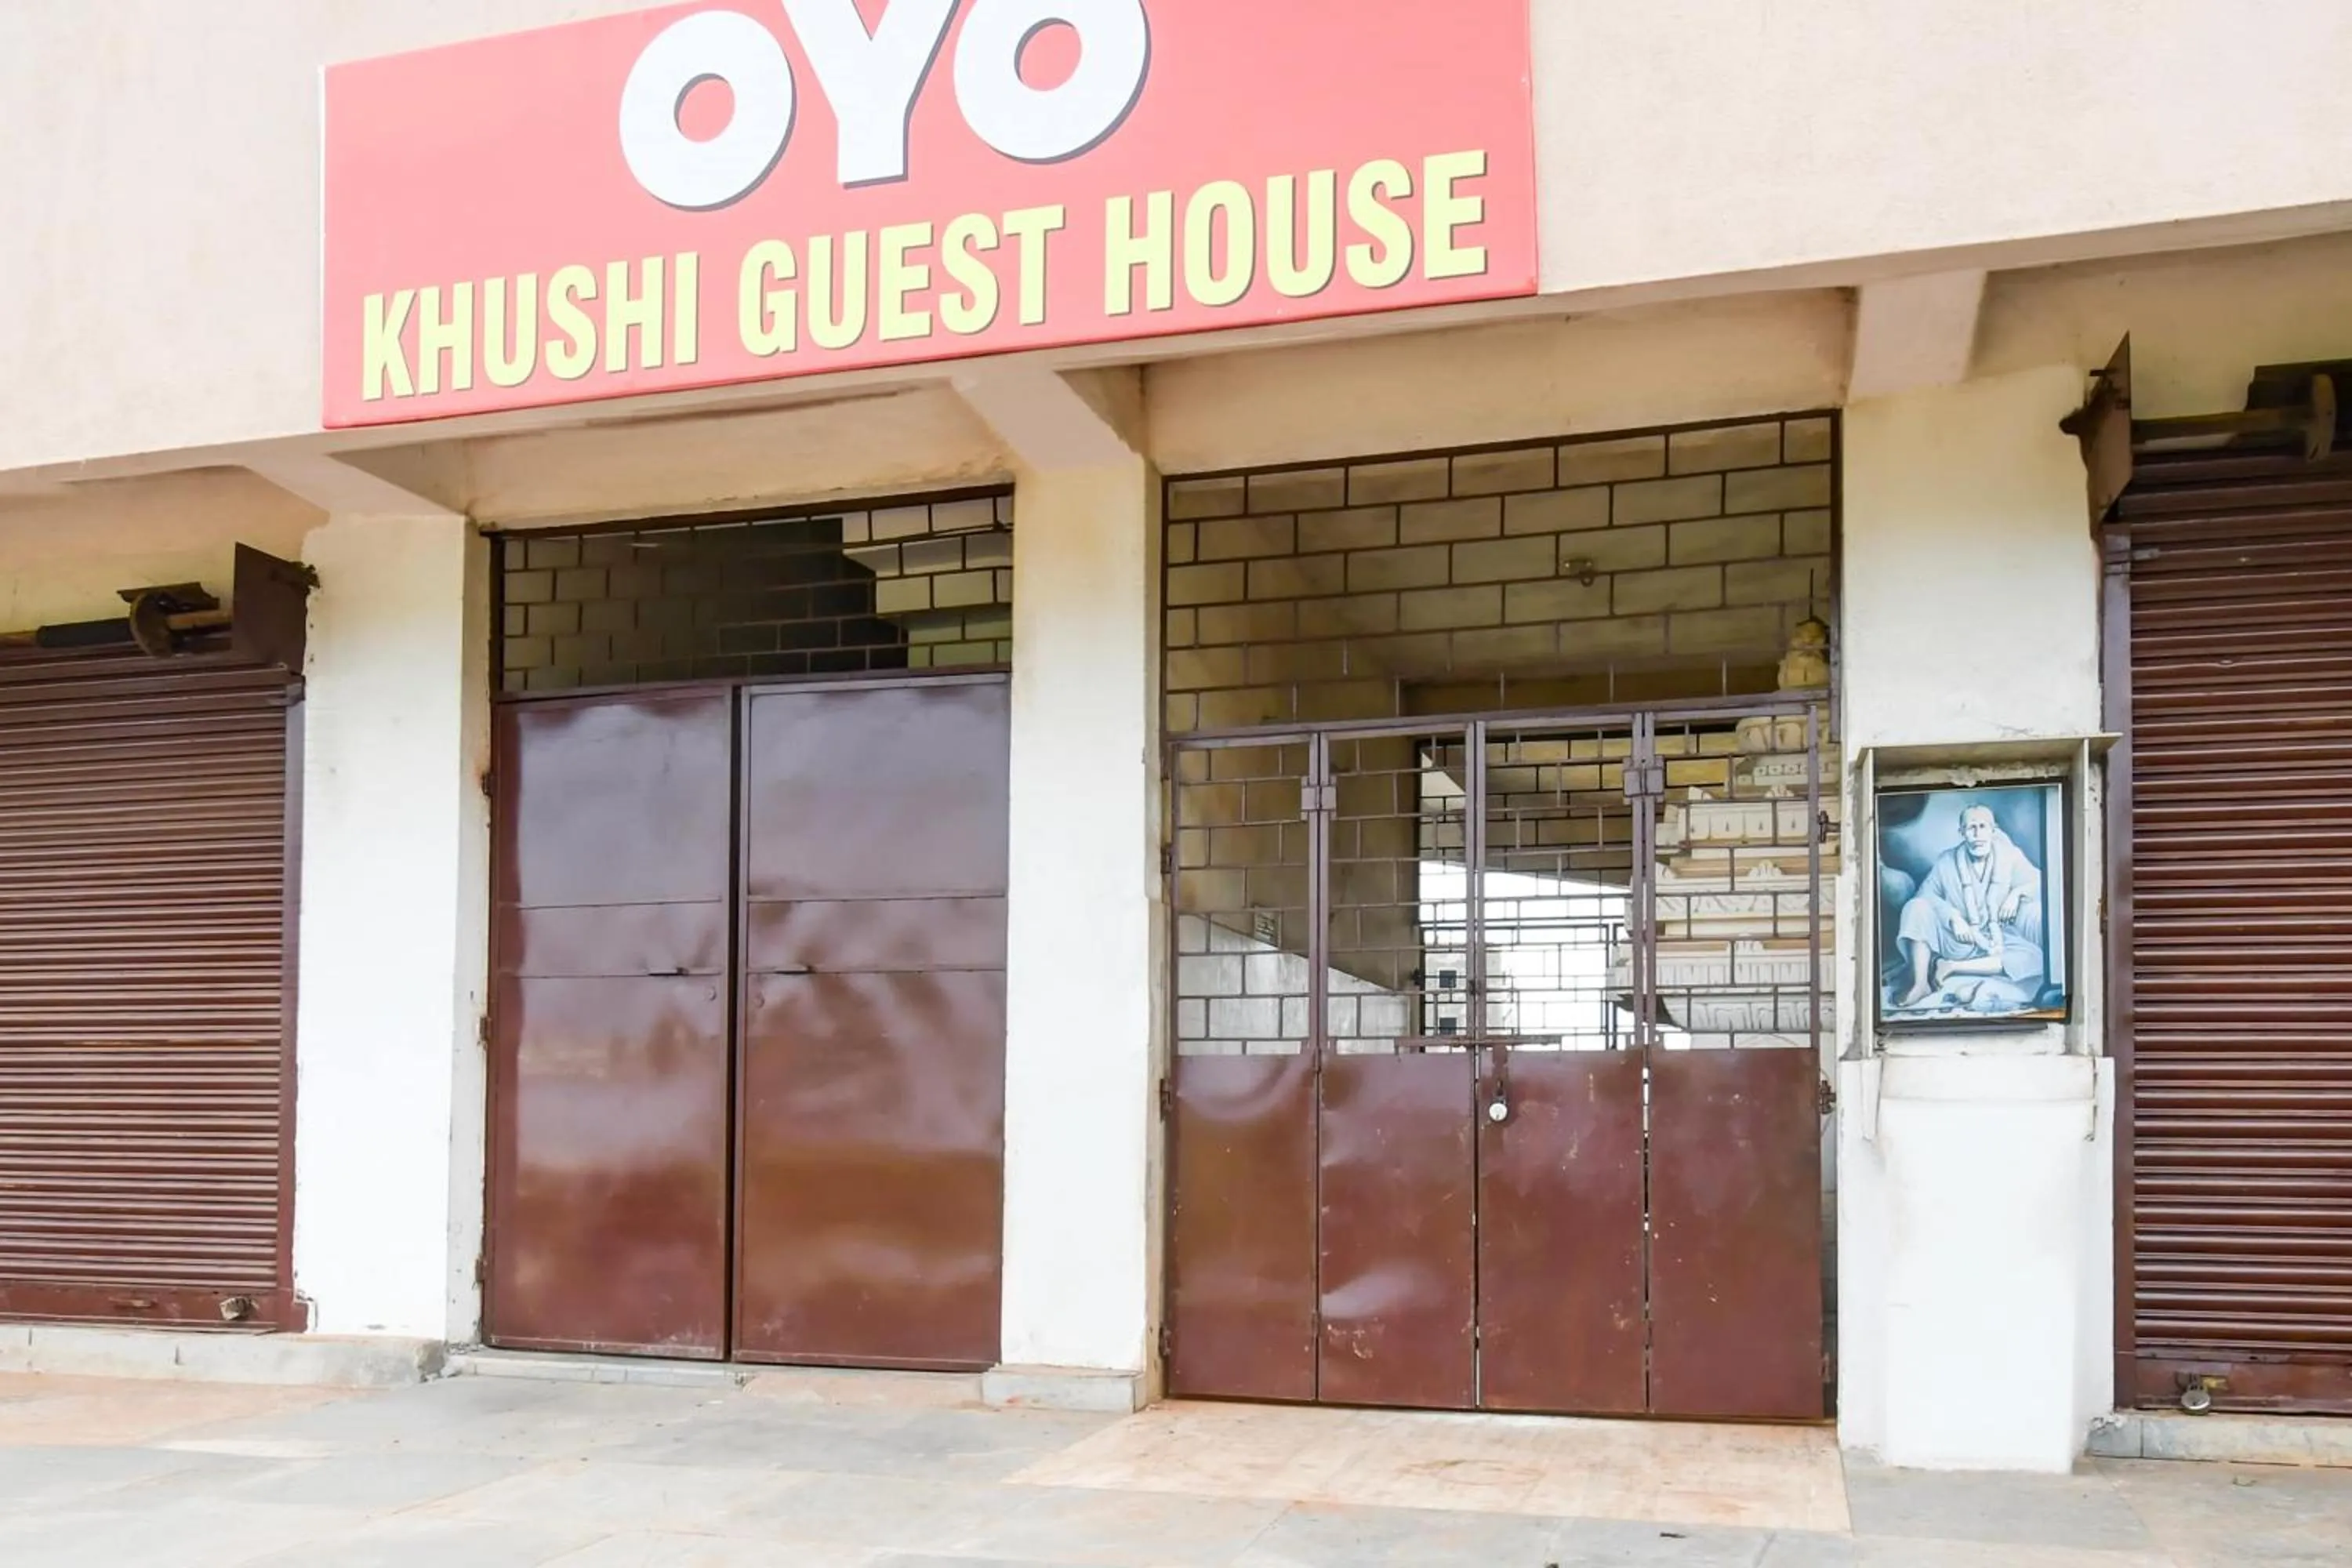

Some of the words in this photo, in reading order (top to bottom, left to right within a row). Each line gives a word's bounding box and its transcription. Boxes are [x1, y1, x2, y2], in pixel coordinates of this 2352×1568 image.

[619, 0, 1151, 212] OYO
[362, 251, 699, 401] KHUSHI
[738, 205, 1065, 358] GUEST
[1104, 150, 1488, 316] HOUSE
